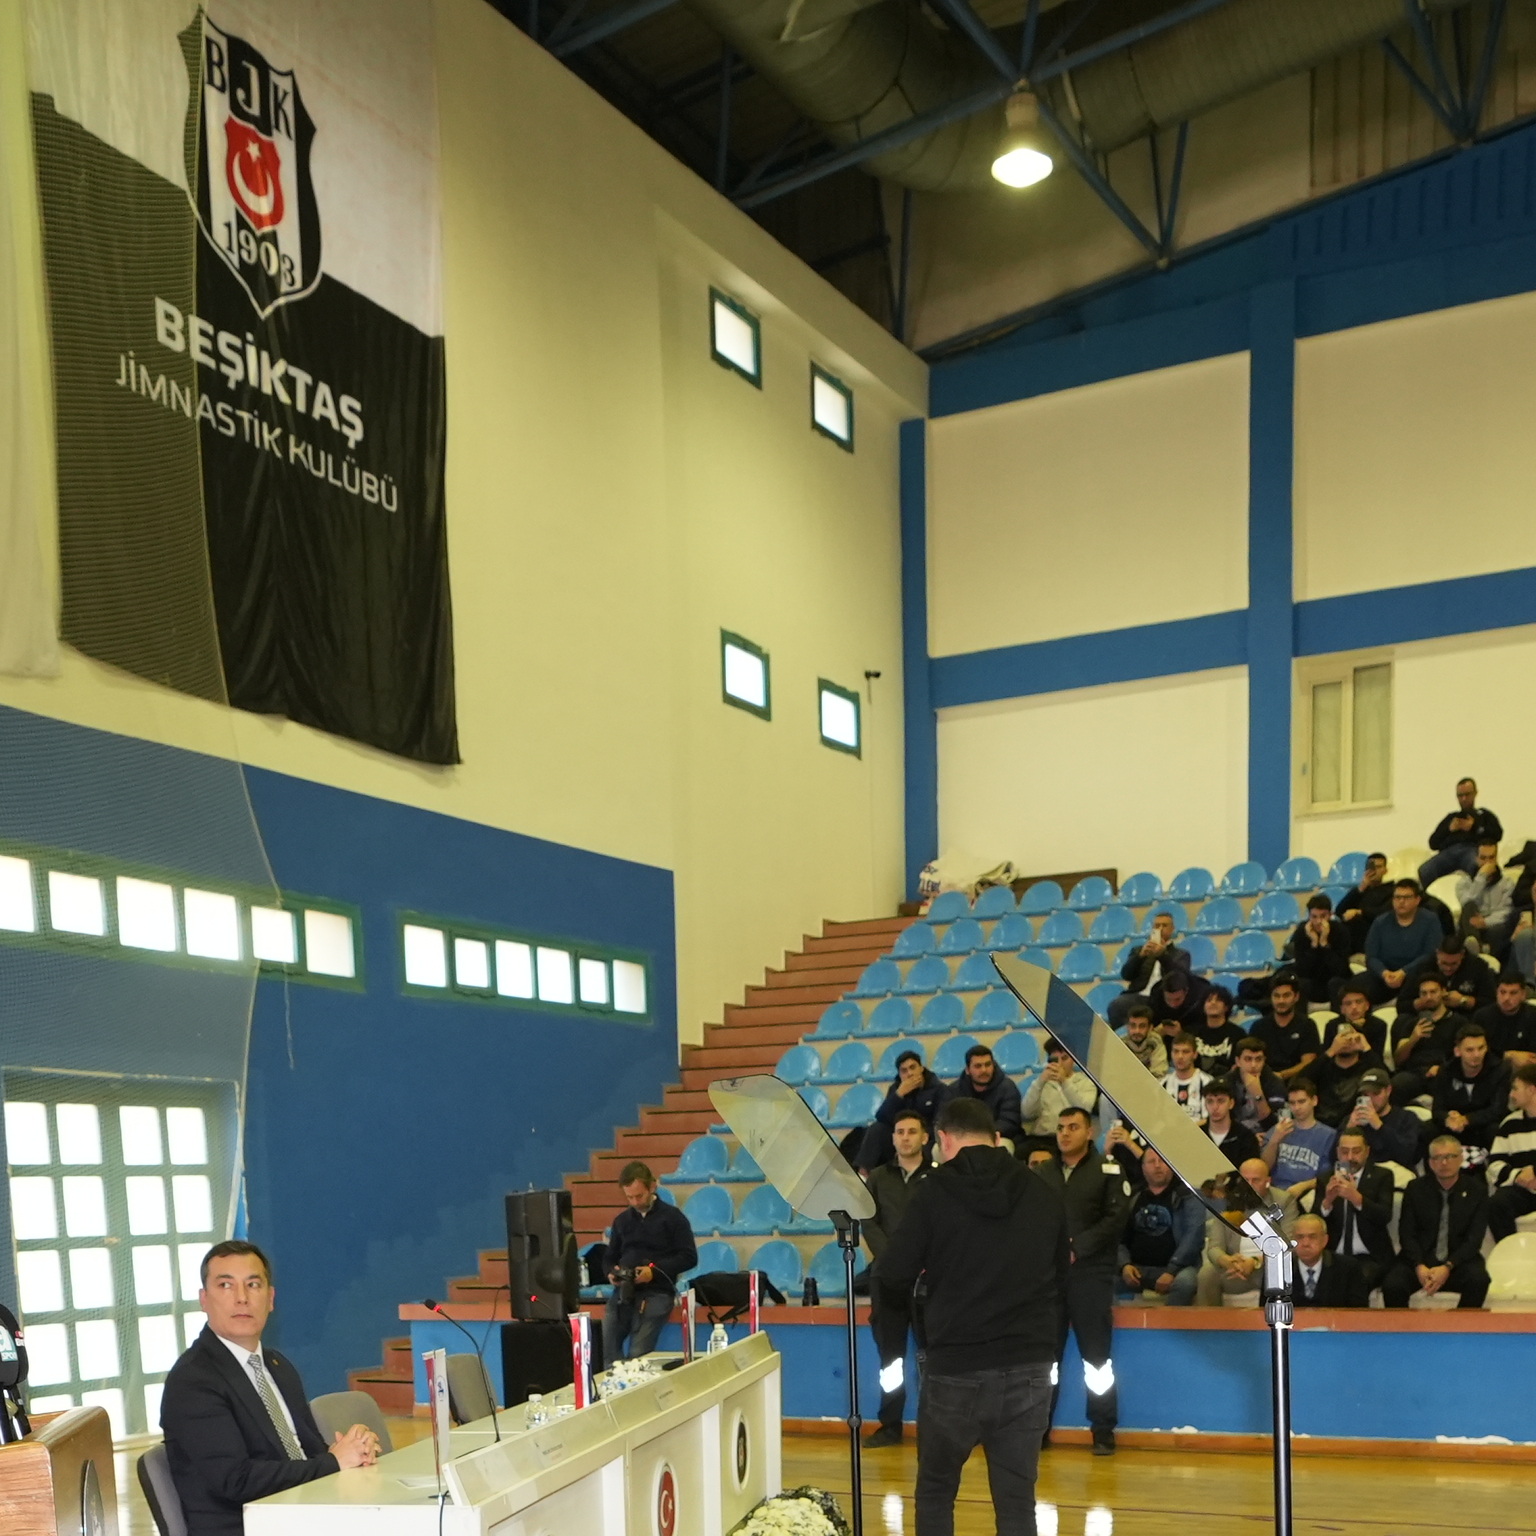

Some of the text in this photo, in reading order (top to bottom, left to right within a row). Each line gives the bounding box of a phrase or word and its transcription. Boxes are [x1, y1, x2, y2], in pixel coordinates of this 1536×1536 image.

[205, 35, 294, 141] BJK
[223, 220, 296, 287] 1903
[116, 351, 398, 512] JİMNASTİK KULÜBÜ
[155, 296, 364, 449] BEŞİKTAŞ
